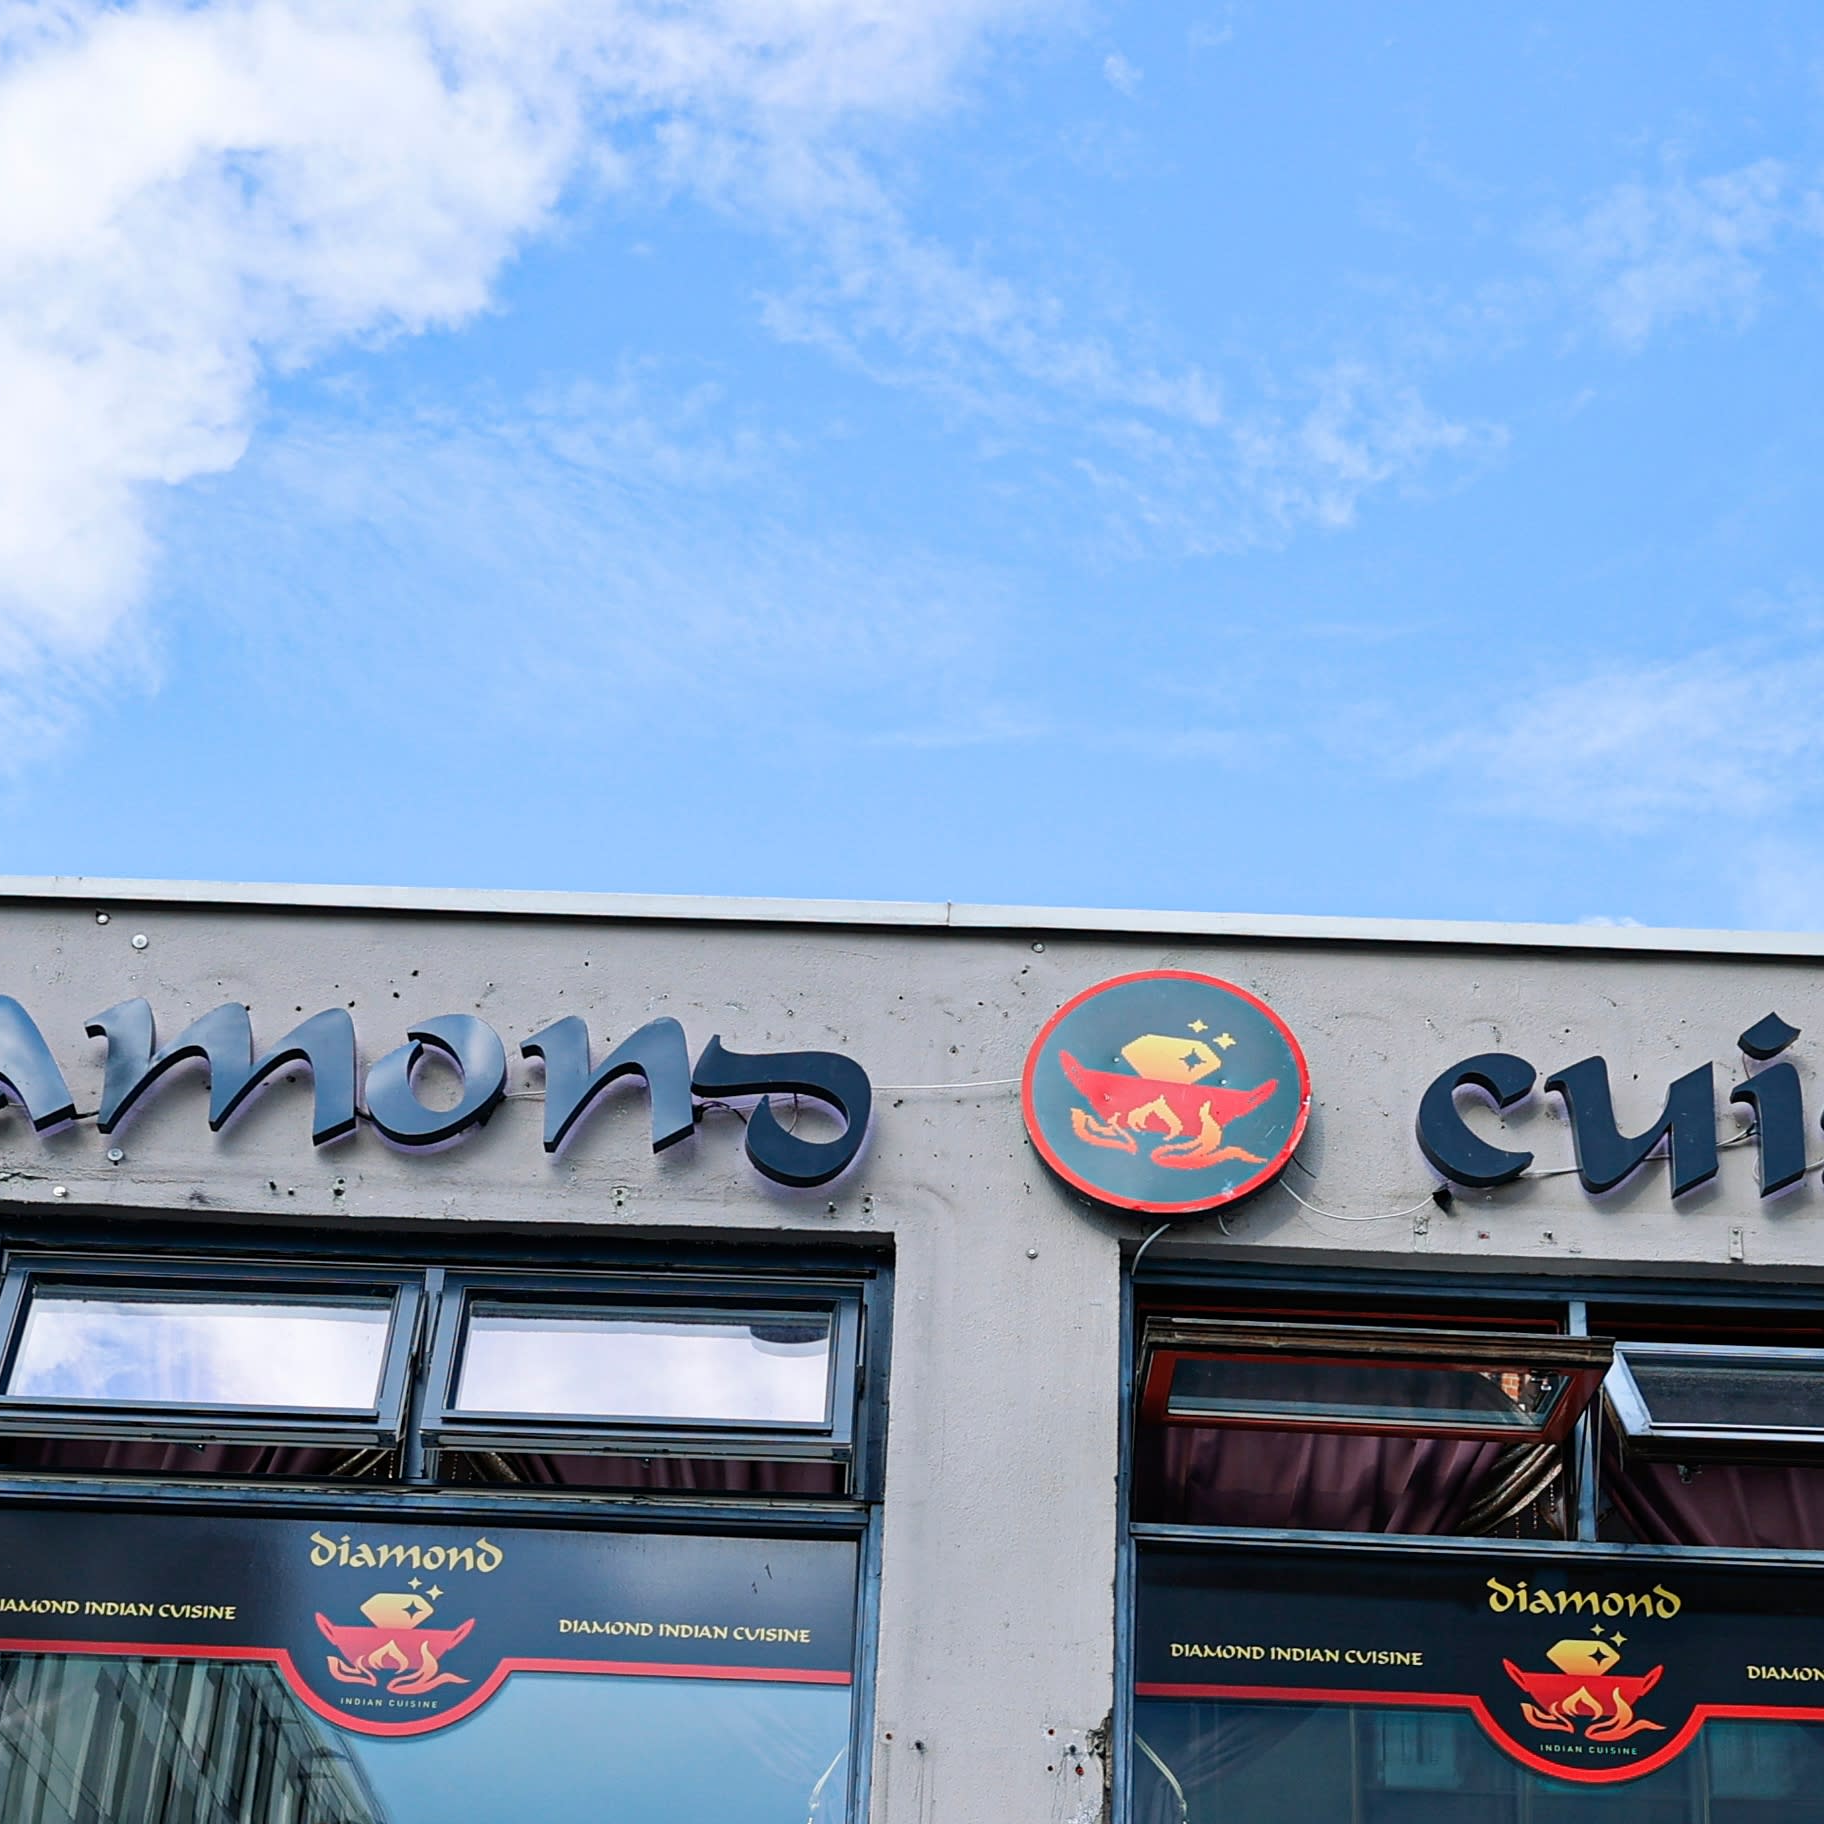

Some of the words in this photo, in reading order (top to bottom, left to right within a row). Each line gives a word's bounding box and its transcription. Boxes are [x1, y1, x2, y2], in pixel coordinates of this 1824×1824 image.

[310, 1530, 503, 1573] diamond
[1486, 1577, 1681, 1619] diamond
[84, 1601, 154, 1617] INDIAN
[158, 1604, 237, 1620] CUISINE
[559, 1619, 654, 1637] DIAMOND
[658, 1623, 728, 1640] INDIAN
[732, 1626, 811, 1643] CUISINE
[1170, 1643, 1265, 1660] DIAMOND
[1270, 1646, 1340, 1663] INDIAN
[1344, 1649, 1424, 1666] CUISINE
[340, 1697, 383, 1707] INDIAN
[388, 1699, 438, 1709] CUISINE
[1540, 1744, 1583, 1753] INDIAN
[1588, 1746, 1637, 1756] CUISINE
